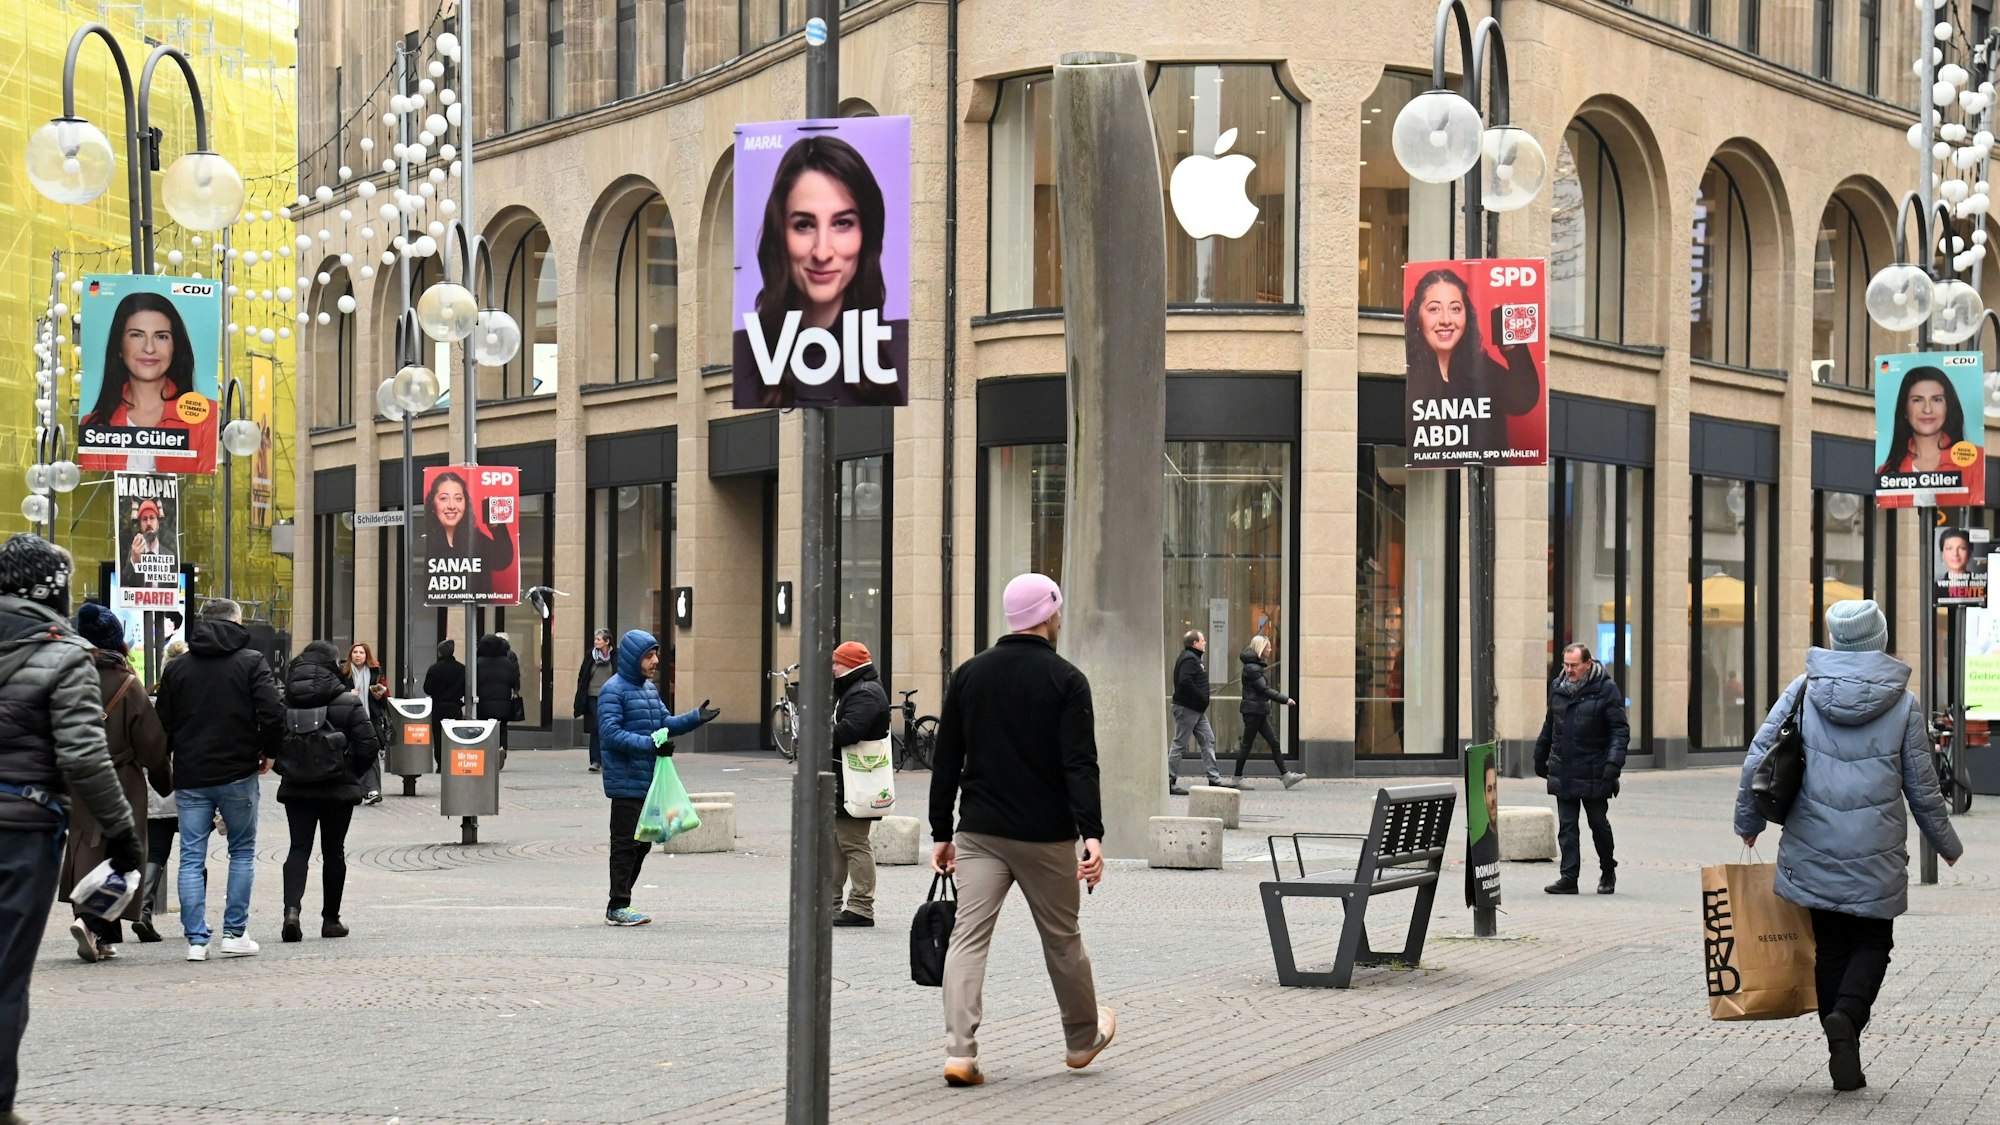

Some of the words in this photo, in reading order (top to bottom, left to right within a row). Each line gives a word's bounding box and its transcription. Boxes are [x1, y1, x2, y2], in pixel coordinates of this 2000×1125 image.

[744, 135, 783, 151] MARAL
[1490, 267, 1537, 287] SPD
[182, 285, 211, 295] CDU
[1509, 318, 1532, 329] SPD
[743, 308, 898, 386] Volt
[1412, 397, 1491, 421] SANAE
[85, 429, 132, 448] Serap
[136, 430, 185, 446] Güler
[1413, 425, 1469, 447] ABDI
[1414, 452, 1440, 460] PLAKAT
[1442, 451, 1481, 460] SCANNEN,
[1483, 450, 1500, 458] SPD
[1501, 449, 1539, 458] WÄHLEN!
[481, 472, 513, 486] SPD
[1881, 475, 1917, 488] Serap
[1919, 473, 1958, 486] Güler
[357, 514, 403, 524] Schildergasse
[142, 556, 174, 564] KANZLER
[428, 558, 481, 573] SANAE
[137, 564, 169, 572] VORBILD
[147, 573, 176, 581] MENSCH
[428, 576, 466, 590] ABDI
[124, 591, 134, 600] Die
[135, 591, 174, 606] PARTEI
[1475, 863, 1494, 879] ROMAN
[1758, 933, 1798, 942] RESERVED
